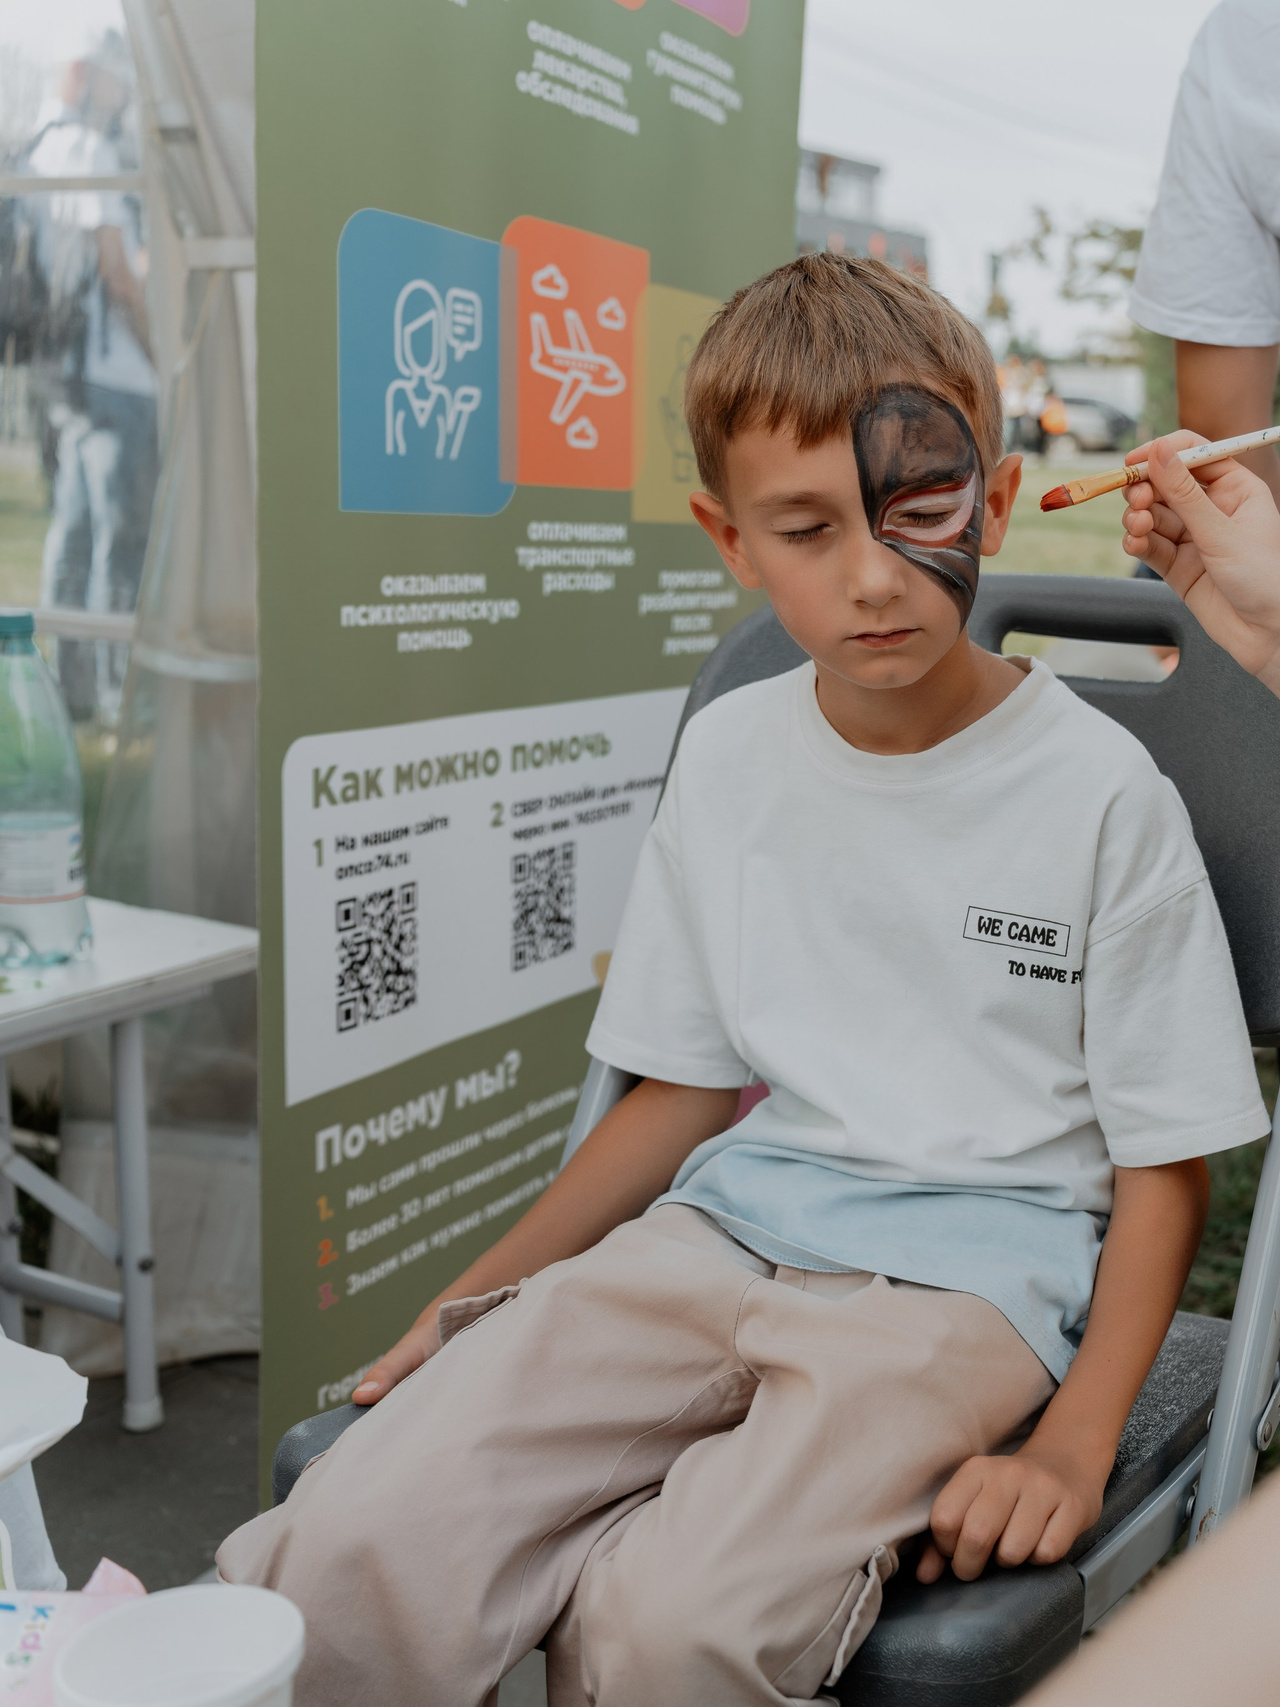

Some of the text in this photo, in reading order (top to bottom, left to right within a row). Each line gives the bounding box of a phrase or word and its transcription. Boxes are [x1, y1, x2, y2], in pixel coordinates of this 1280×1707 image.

[527, 521, 626, 541] оплачиваем
[516, 546, 635, 569] транспортные
[380, 574, 486, 596] оказываем
[542, 571, 615, 594] расходы
[340, 599, 520, 626] психологическую
[397, 629, 472, 651] помощь
[312, 733, 612, 809] Как можно помочь
[490, 803, 505, 827] 2
[313, 814, 450, 867] 1 На нашем сайте
[334, 853, 411, 881] onco74.ru
[977, 915, 1057, 947] WE CAME
[1008, 960, 1026, 976] TO
[1030, 964, 1067, 983] HAVE
[314, 1050, 521, 1172] Почему мы?
[316, 1196, 335, 1221] 1.
[346, 1188, 377, 1209] Мы
[378, 1165, 417, 1192] сами
[419, 1137, 482, 1173] прошли
[317, 1240, 340, 1266] 2.
[345, 1217, 398, 1252] Более
[399, 1198, 422, 1225] 30
[422, 1187, 452, 1213] лет
[452, 1157, 523, 1197] помогаем
[345, 1259, 399, 1295] Знаем
[401, 1240, 430, 1263] как
[430, 1214, 483, 1247] нужно
